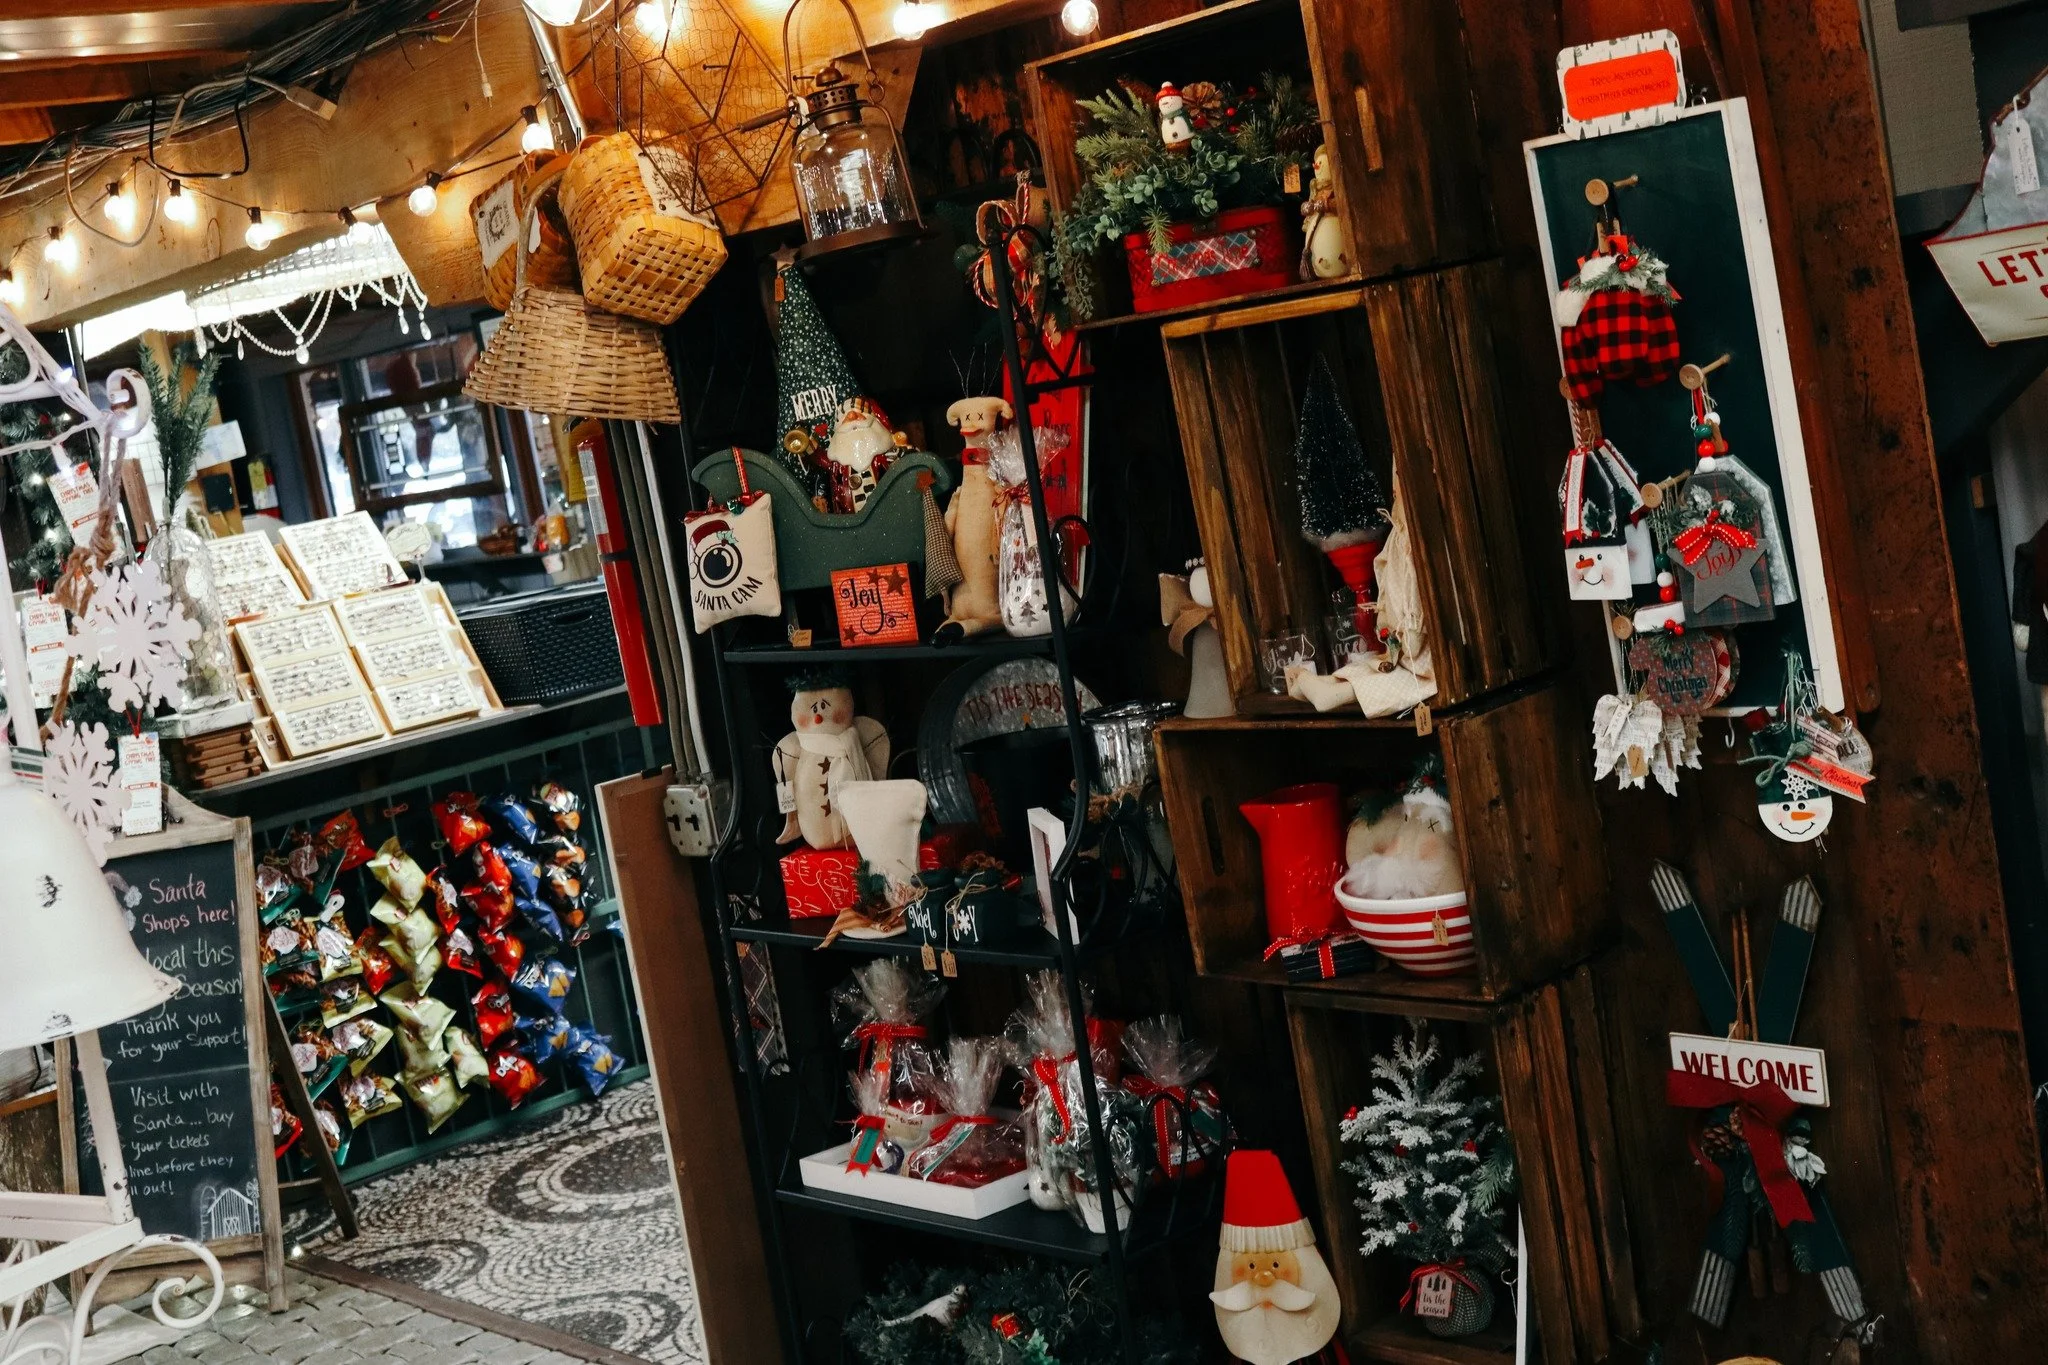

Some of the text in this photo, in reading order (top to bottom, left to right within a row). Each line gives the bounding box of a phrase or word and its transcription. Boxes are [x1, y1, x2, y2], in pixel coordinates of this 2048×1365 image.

[790, 384, 839, 421] MERRY
[694, 576, 764, 611] SANTA CAM
[839, 577, 908, 635] Joy
[990, 686, 1022, 716] THE
[1024, 683, 1083, 714] SEASN
[149, 873, 207, 904] Santa
[143, 899, 236, 934] Shops here!
[193, 937, 236, 968] this
[116, 1012, 222, 1037] Thank you
[117, 1025, 248, 1063] for your Support!
[1679, 1050, 1818, 1094] WELCOME
[130, 1081, 220, 1108] Visit with
[205, 1107, 235, 1129] buy
[131, 1134, 211, 1161] your tickets
[155, 1157, 196, 1175] before
[199, 1156, 234, 1169] they
[143, 1180, 175, 1197] out!
